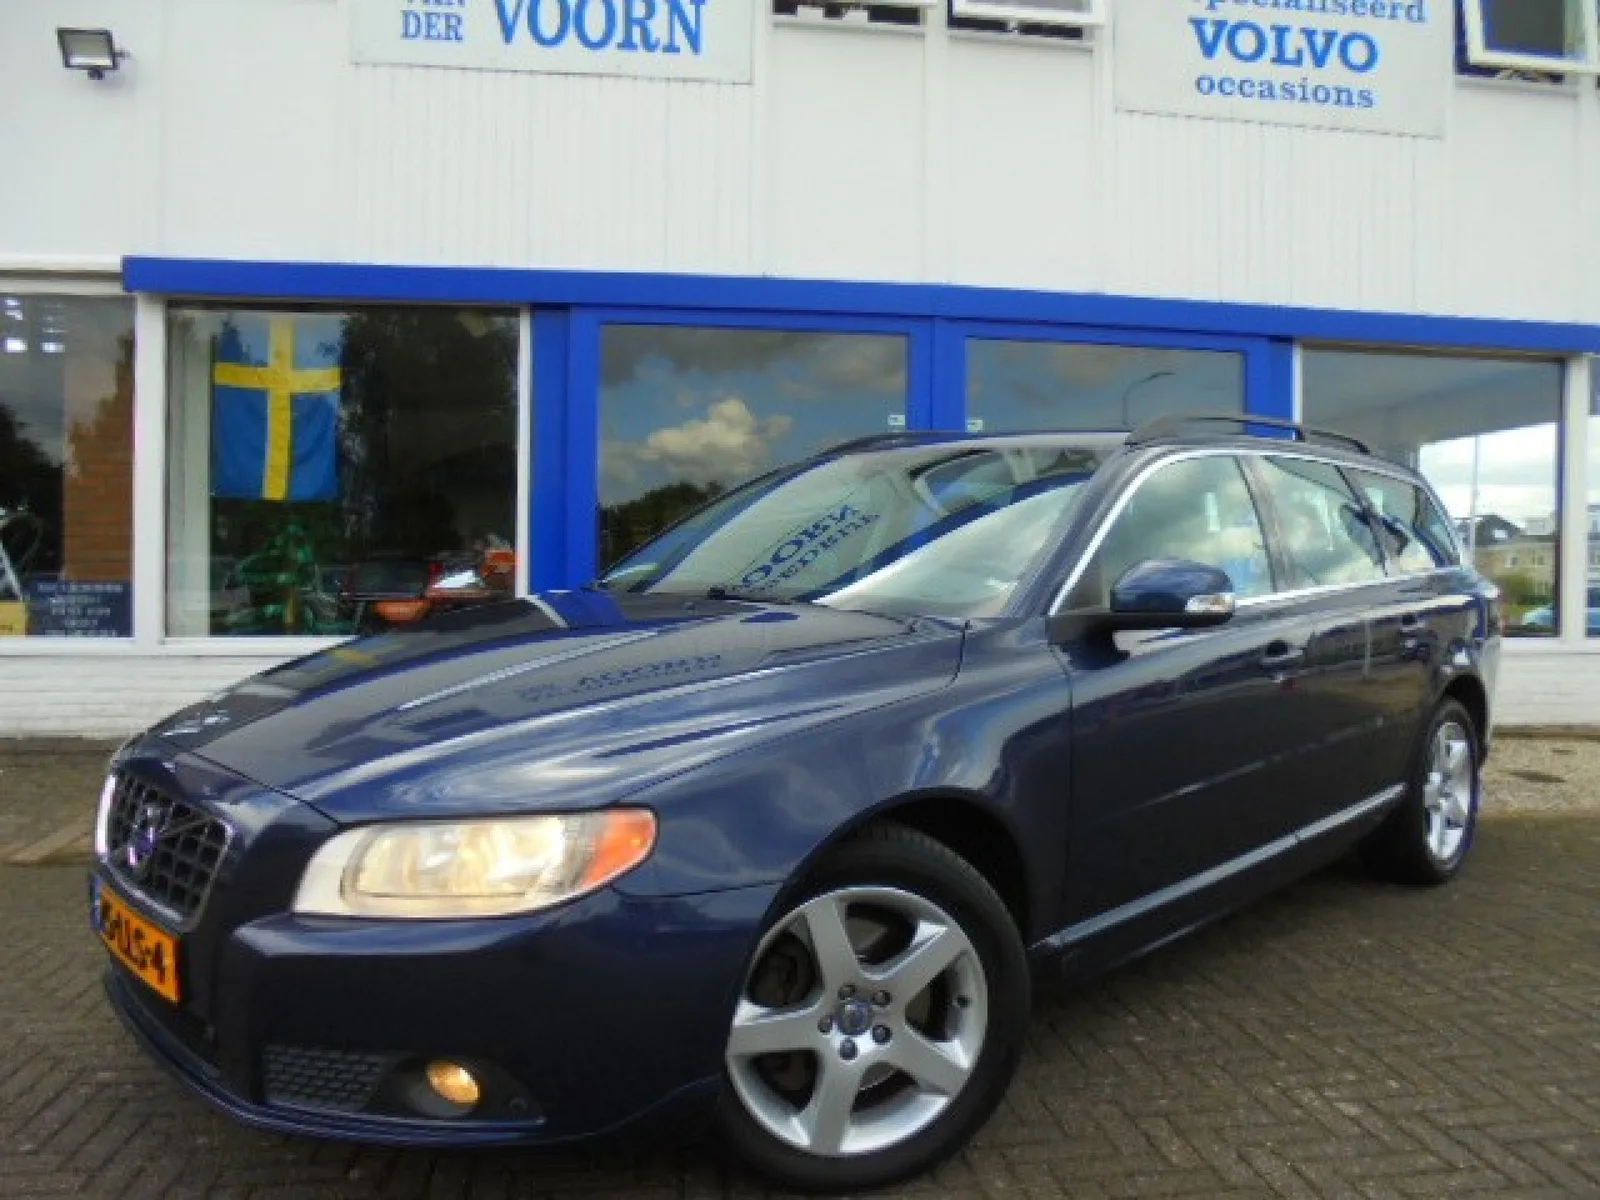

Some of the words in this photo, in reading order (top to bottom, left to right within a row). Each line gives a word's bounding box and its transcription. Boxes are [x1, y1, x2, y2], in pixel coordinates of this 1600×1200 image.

[400, 10, 464, 42] DER
[494, 0, 707, 55] VOORN
[1188, 17, 1379, 73] VOLVO
[1195, 74, 1374, 108] occasions
